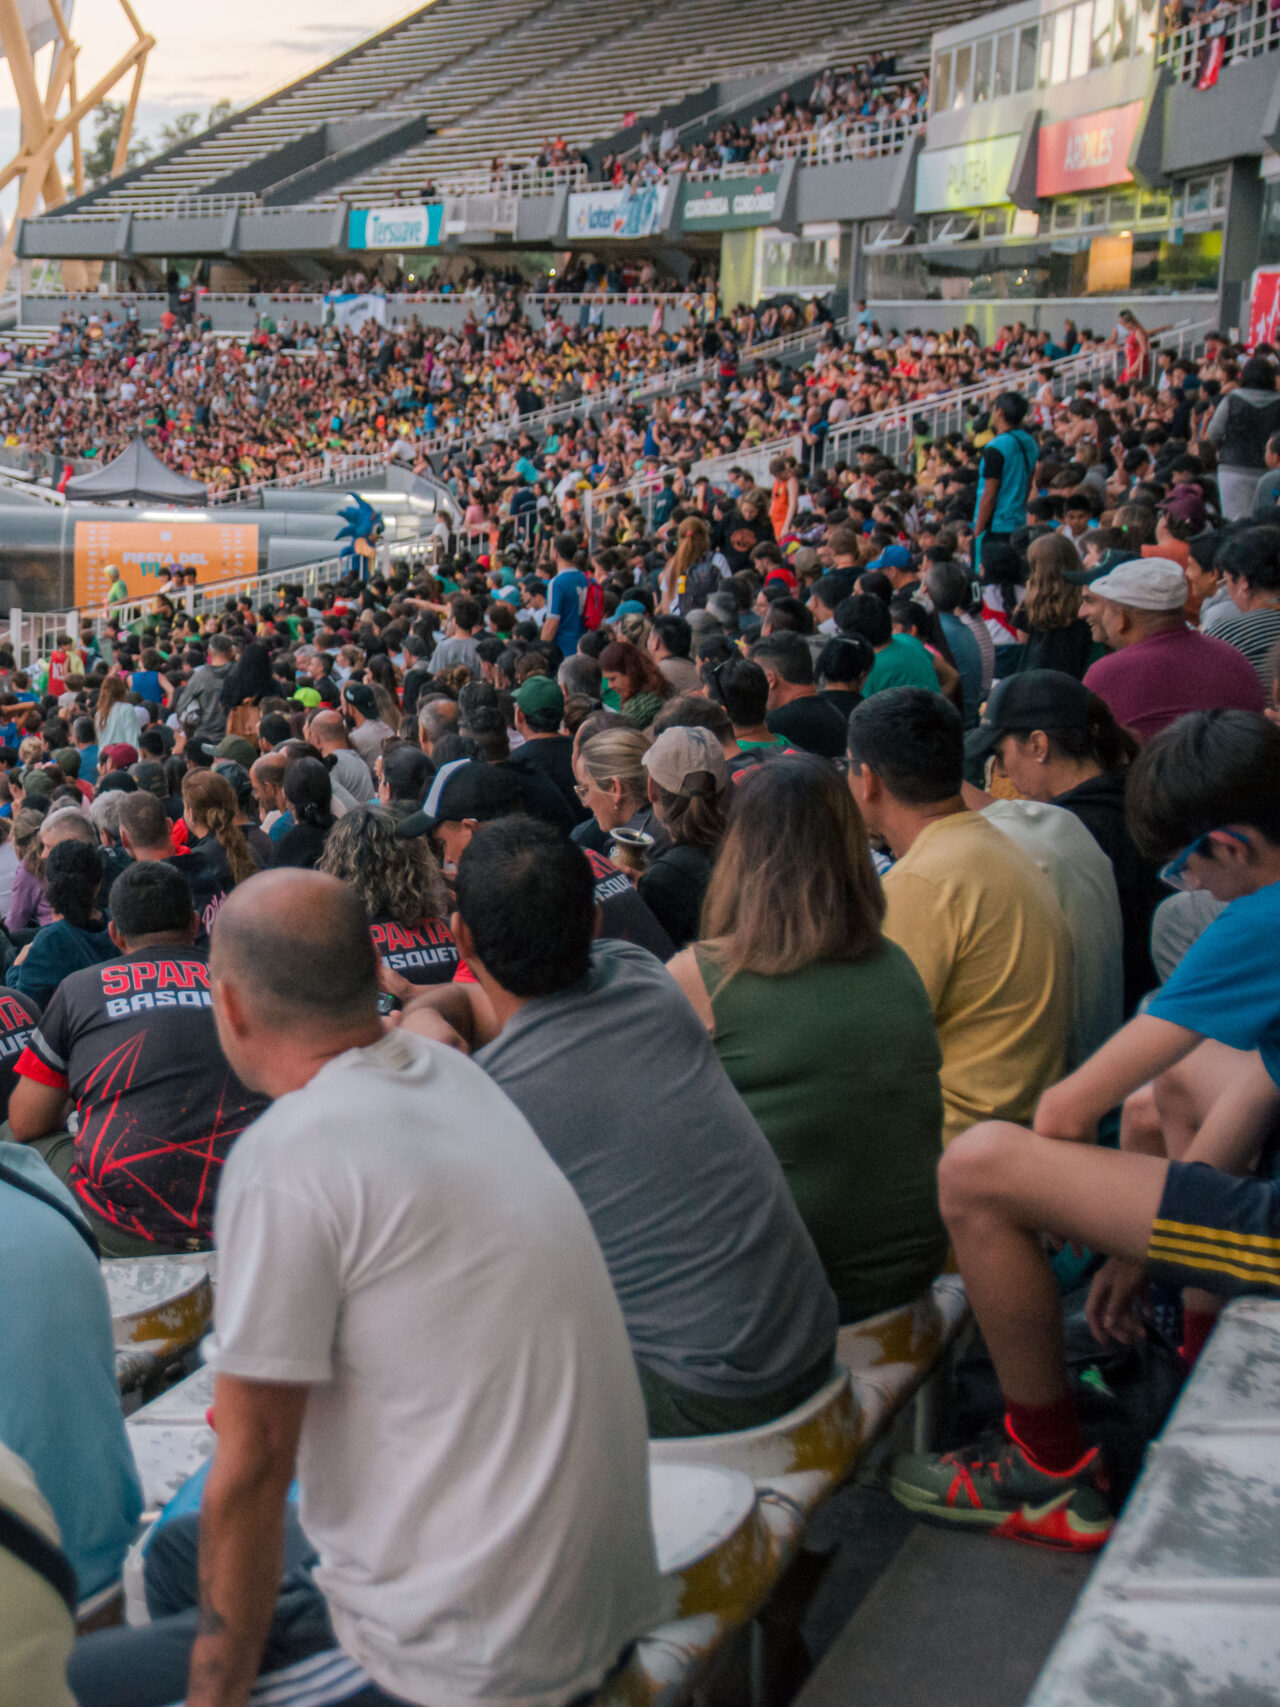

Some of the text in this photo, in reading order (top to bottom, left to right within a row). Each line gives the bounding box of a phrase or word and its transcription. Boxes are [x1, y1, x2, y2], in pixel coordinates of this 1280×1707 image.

[947, 158, 989, 194] PLATEA
[372, 216, 423, 244] Tersuave
[122, 552, 208, 565] FIESTA DEL
[101, 960, 211, 995] SPAR
